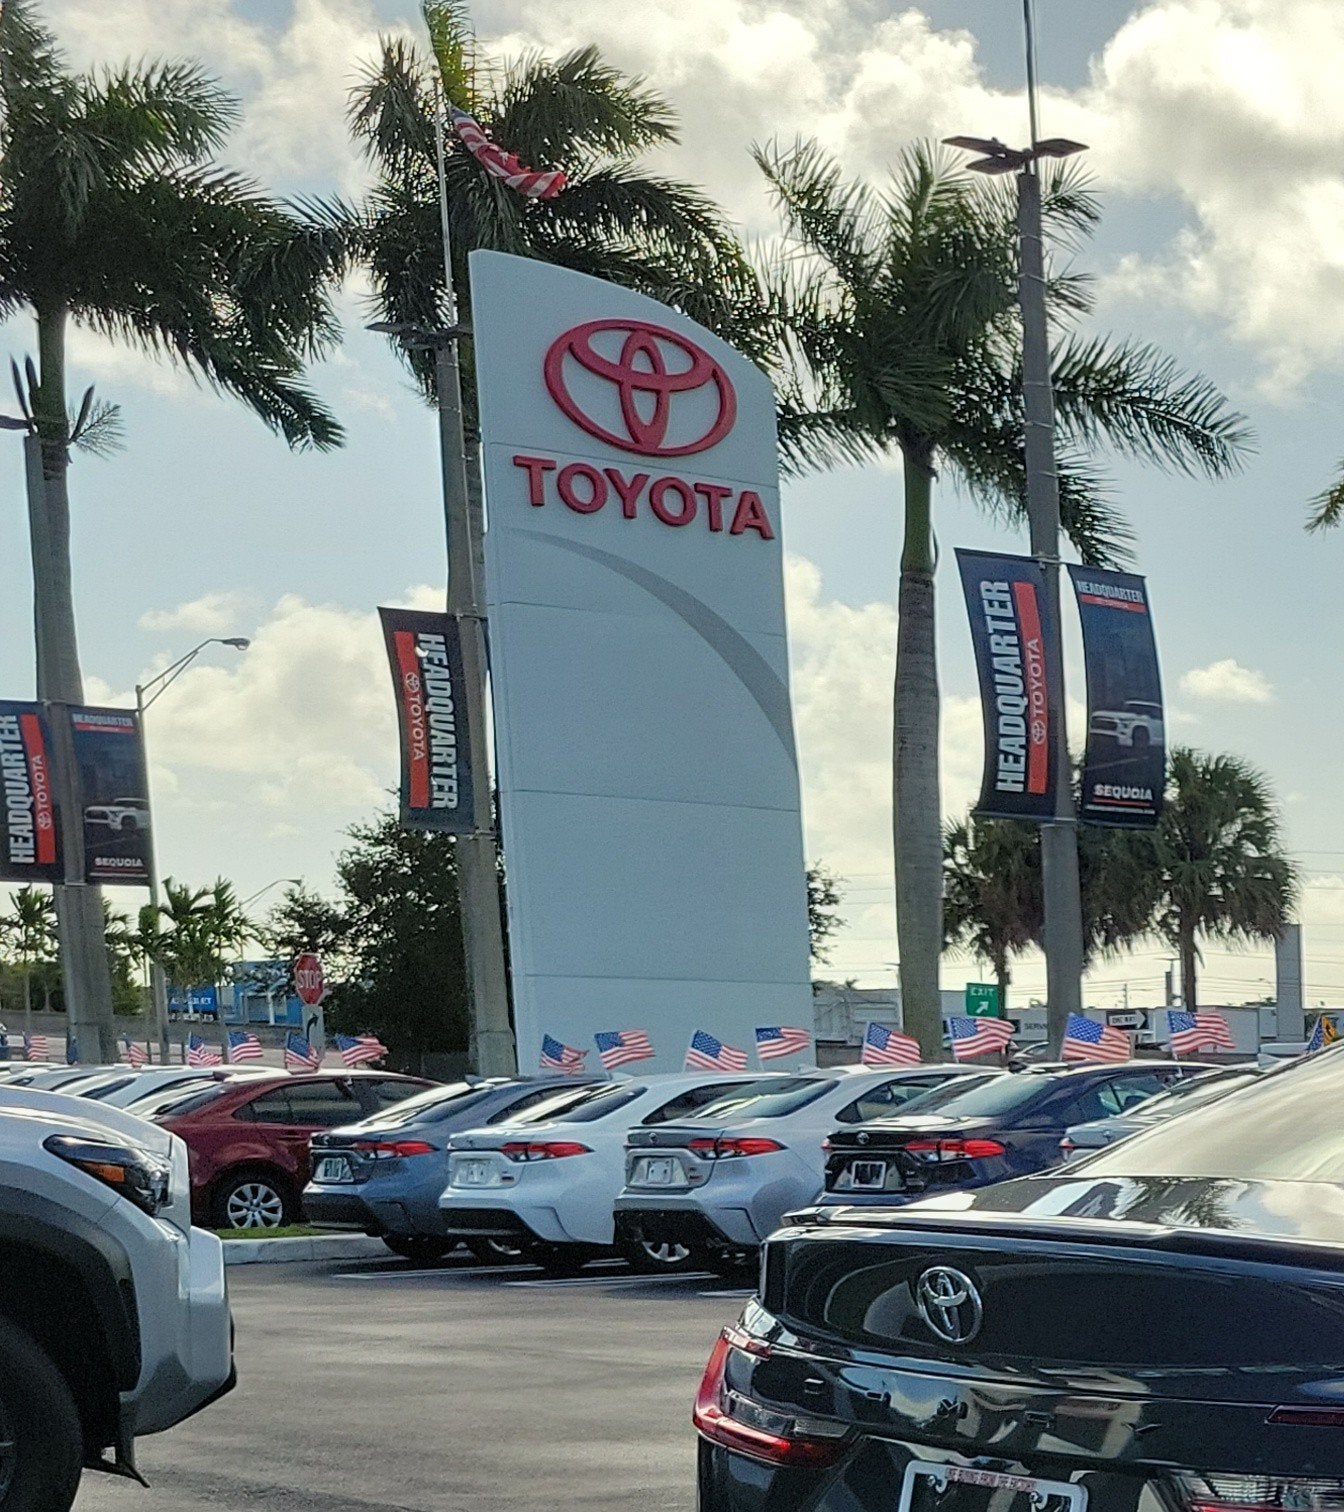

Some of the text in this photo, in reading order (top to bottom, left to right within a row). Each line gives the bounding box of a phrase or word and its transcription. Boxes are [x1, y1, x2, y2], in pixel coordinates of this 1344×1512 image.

[513, 455, 775, 540] TOYOTA
[979, 580, 1029, 793] HEADQUARTER
[1027, 638, 1044, 717] TOYOTA
[409, 694, 426, 760] TOYOTA
[416, 633, 458, 809] HEADQUARTER
[0, 715, 35, 864] HEADQUARTER
[32, 754, 50, 810] TOYOTA
[1094, 784, 1153, 800] SEQUOIA
[94, 856, 144, 868] SEQUOIA
[299, 969, 321, 989] STOP
[970, 986, 994, 997] EXIT
